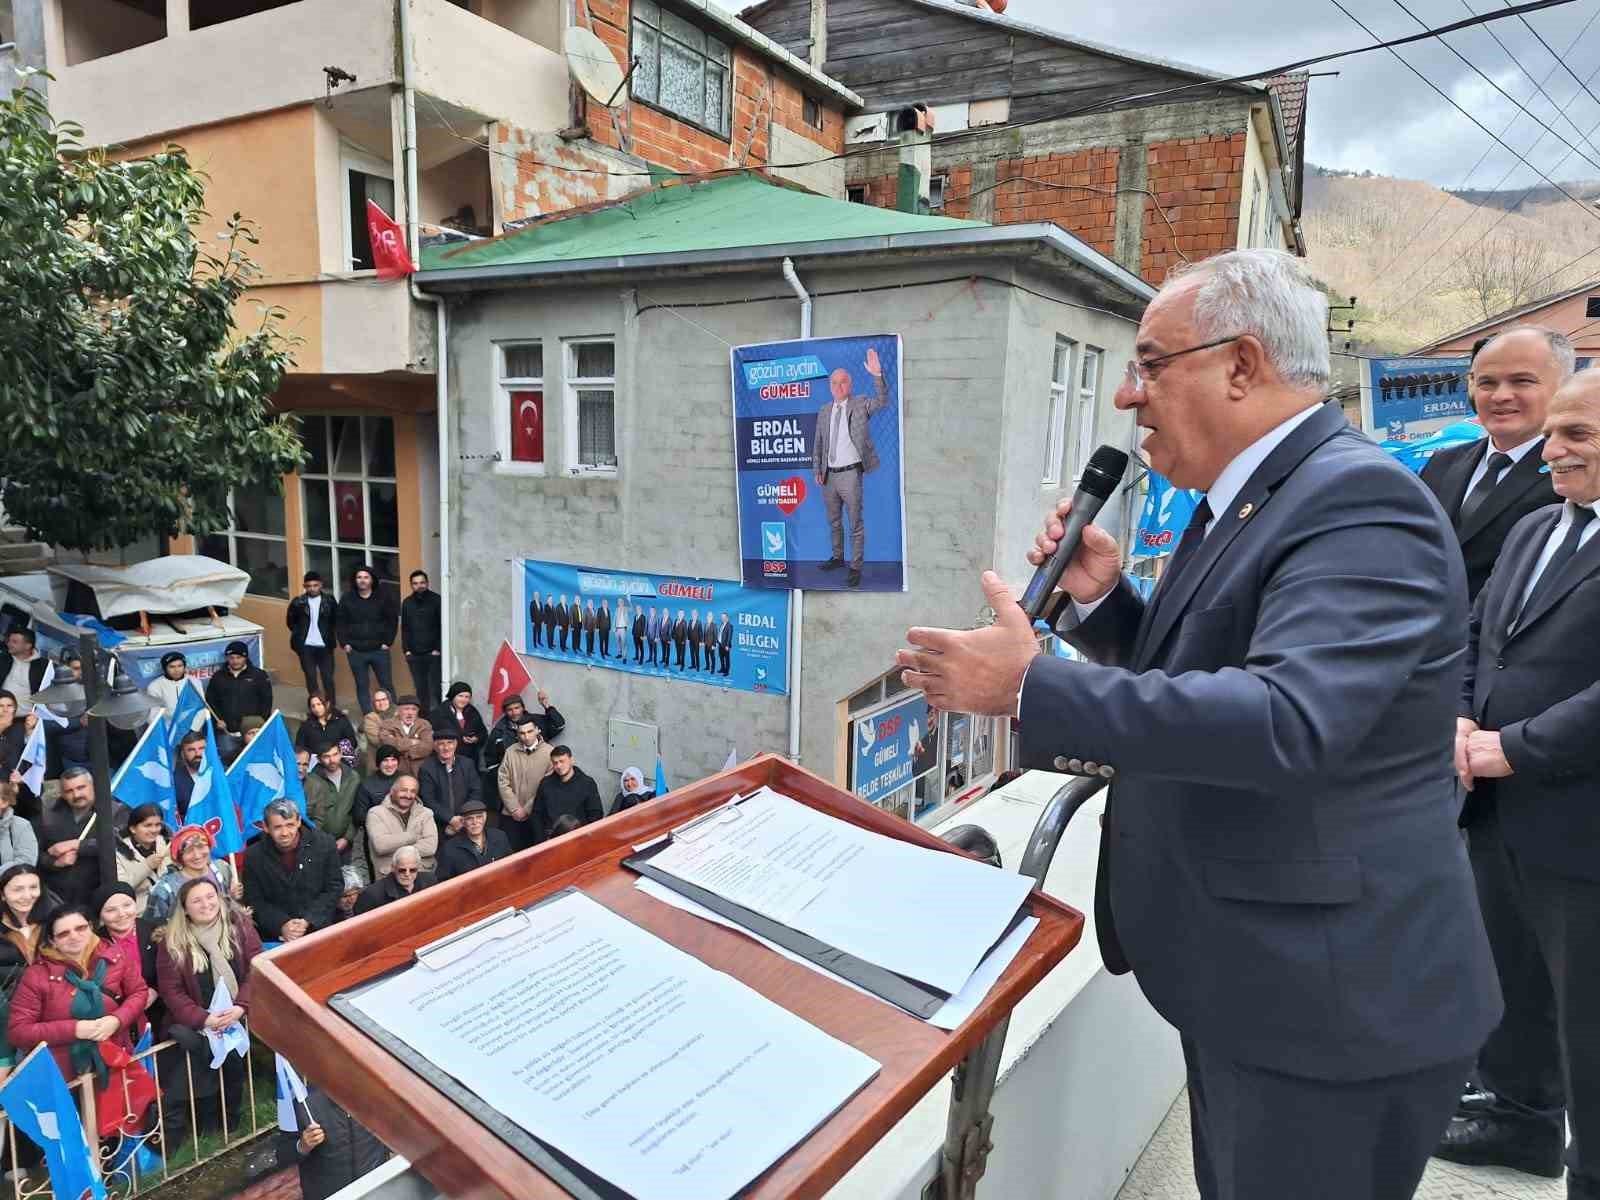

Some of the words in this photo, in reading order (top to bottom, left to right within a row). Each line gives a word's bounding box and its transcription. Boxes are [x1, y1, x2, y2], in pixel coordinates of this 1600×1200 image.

[1423, 401, 1466, 412] ERDAL
[753, 419, 802, 437] ERDAL
[738, 612, 777, 629] ERDAL
